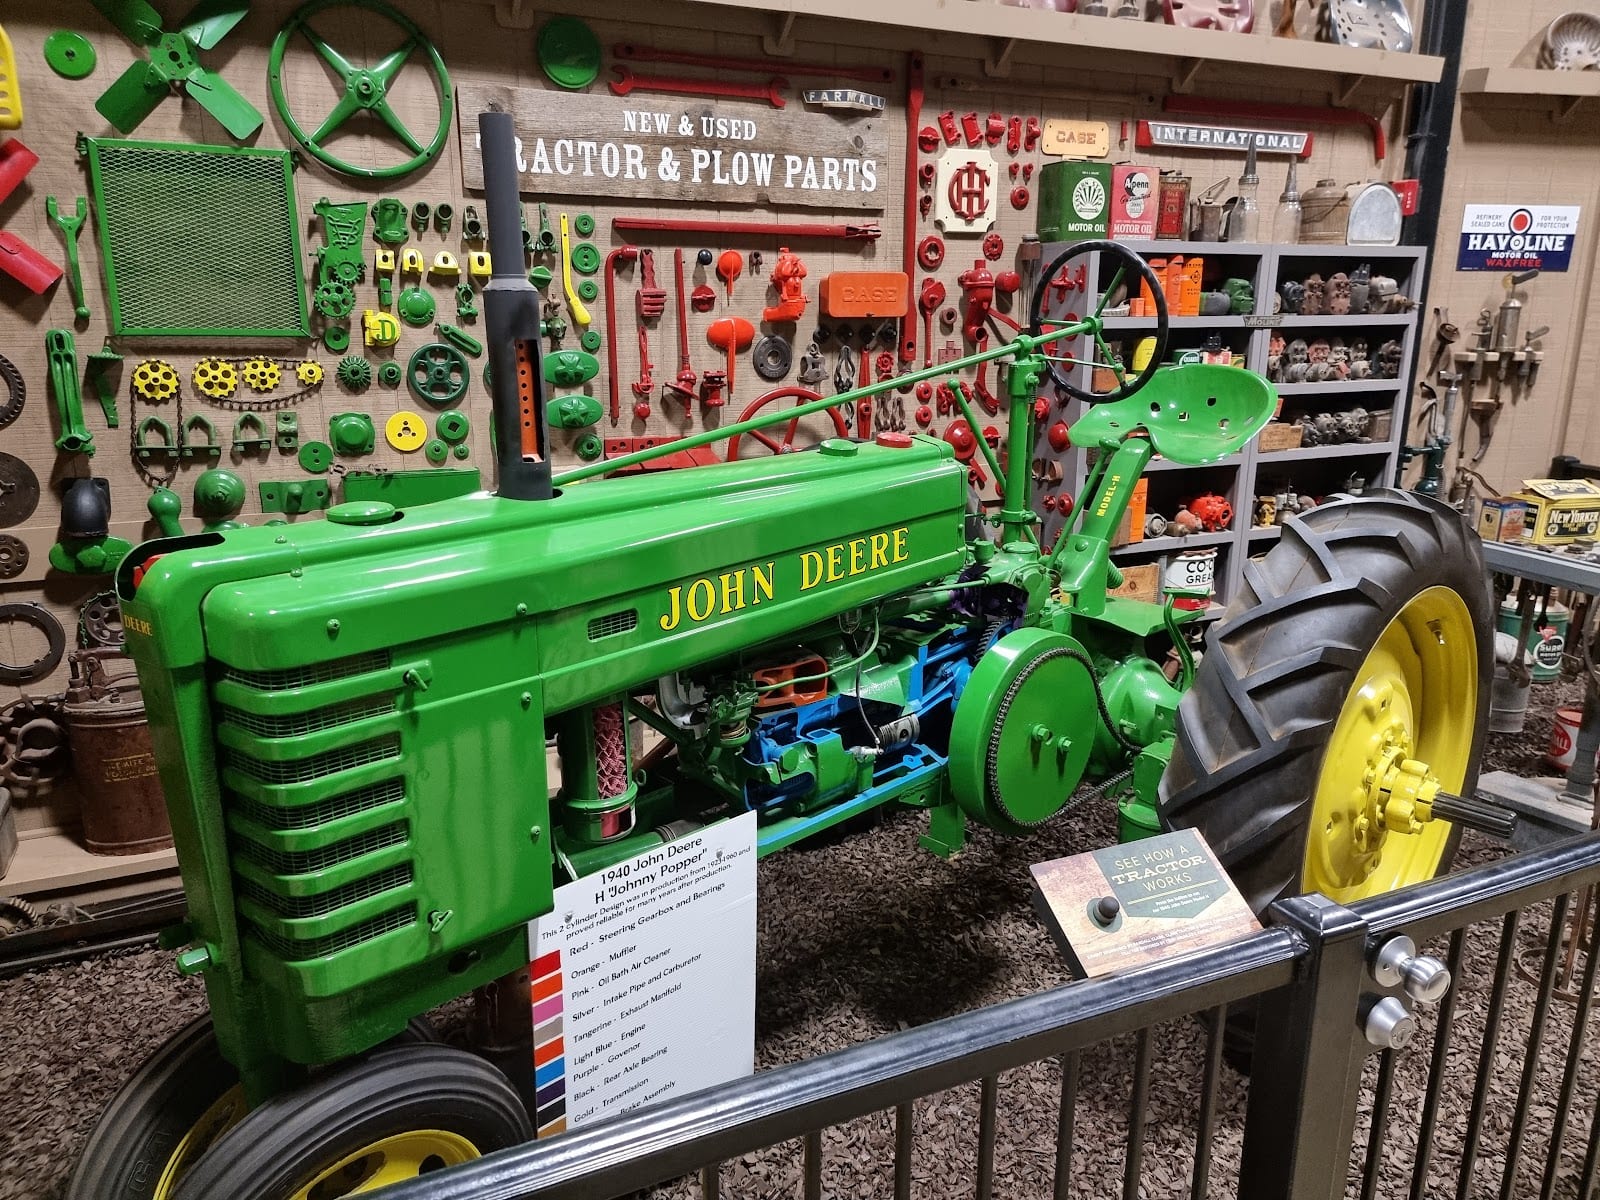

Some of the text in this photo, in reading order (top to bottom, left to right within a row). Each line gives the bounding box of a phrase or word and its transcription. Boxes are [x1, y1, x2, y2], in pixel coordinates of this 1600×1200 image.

[808, 91, 882, 107] FARMALL
[623, 110, 757, 141] NEW & USED
[1055, 130, 1097, 145] CASE
[475, 133, 878, 193] RACTOR & PLOW PARTS
[1068, 223, 1093, 233] MOTOR
[1095, 223, 1106, 233] OIL
[1113, 223, 1153, 234] MOTOR OIL
[1467, 234, 1566, 251] HAVOLINE
[1486, 258, 1543, 268] WAXFREE
[1523, 251, 1538, 259] OIL
[841, 286, 898, 303] CASE
[1096, 475, 1121, 517] MODEL-H
[659, 527, 910, 632] JOHN DEERE
[123, 614, 153, 637] DEERE
[595, 847, 708, 904] H "Johnny Popper"
[601, 837, 702, 885] 1940 John Deere
[1111, 854, 1207, 886] TRACTOR
[1114, 845, 1190, 871] SEE HOW A
[541, 929, 558, 940] This
[559, 925, 564, 933] 2
[566, 912, 598, 931] cylinder
[599, 901, 625, 915] Design
[626, 895, 640, 904] was
[641, 890, 649, 898] in
[650, 873, 689, 896] production
[689, 866, 706, 876] from
[738, 845, 751, 856] and
[1142, 871, 1192, 892] WORKS
[566, 863, 732, 941] proved reliable for many years after production.
[569, 942, 589, 957] Red
[598, 923, 636, 943] Steering
[637, 905, 674, 925] Gearbox
[675, 896, 691, 909] and
[692, 882, 726, 901] Bearings
[571, 962, 601, 979] Orange
[609, 945, 637, 963] Muffler
[571, 986, 590, 1000] Pink
[598, 976, 610, 987] Oil
[611, 968, 629, 981] Bath
[630, 962, 642, 972] Air
[643, 947, 672, 965] Cleaner
[572, 1006, 595, 1022] Silver
[603, 991, 628, 1006] Intake
[629, 981, 646, 994] Pipe
[647, 971, 662, 985] and
[663, 953, 702, 977] Carburetor
[573, 1020, 612, 1043] Tangerine
[620, 1000, 649, 1019] Exhaust
[650, 982, 682, 1004] Manifold
[573, 1050, 594, 1065] Light
[595, 1041, 613, 1055] Blue
[620, 1023, 646, 1041] Engine
[573, 1065, 599, 1082] Purple
[607, 1042, 641, 1063] Govenor
[573, 1085, 595, 1101] Black
[603, 1072, 621, 1086] Rear
[623, 1061, 640, 1075] Axle
[641, 1046, 668, 1065] Bearing
[574, 1107, 594, 1123] Gold
[602, 1078, 649, 1107] Transmission
[620, 1080, 676, 1115] Brake Assembly
